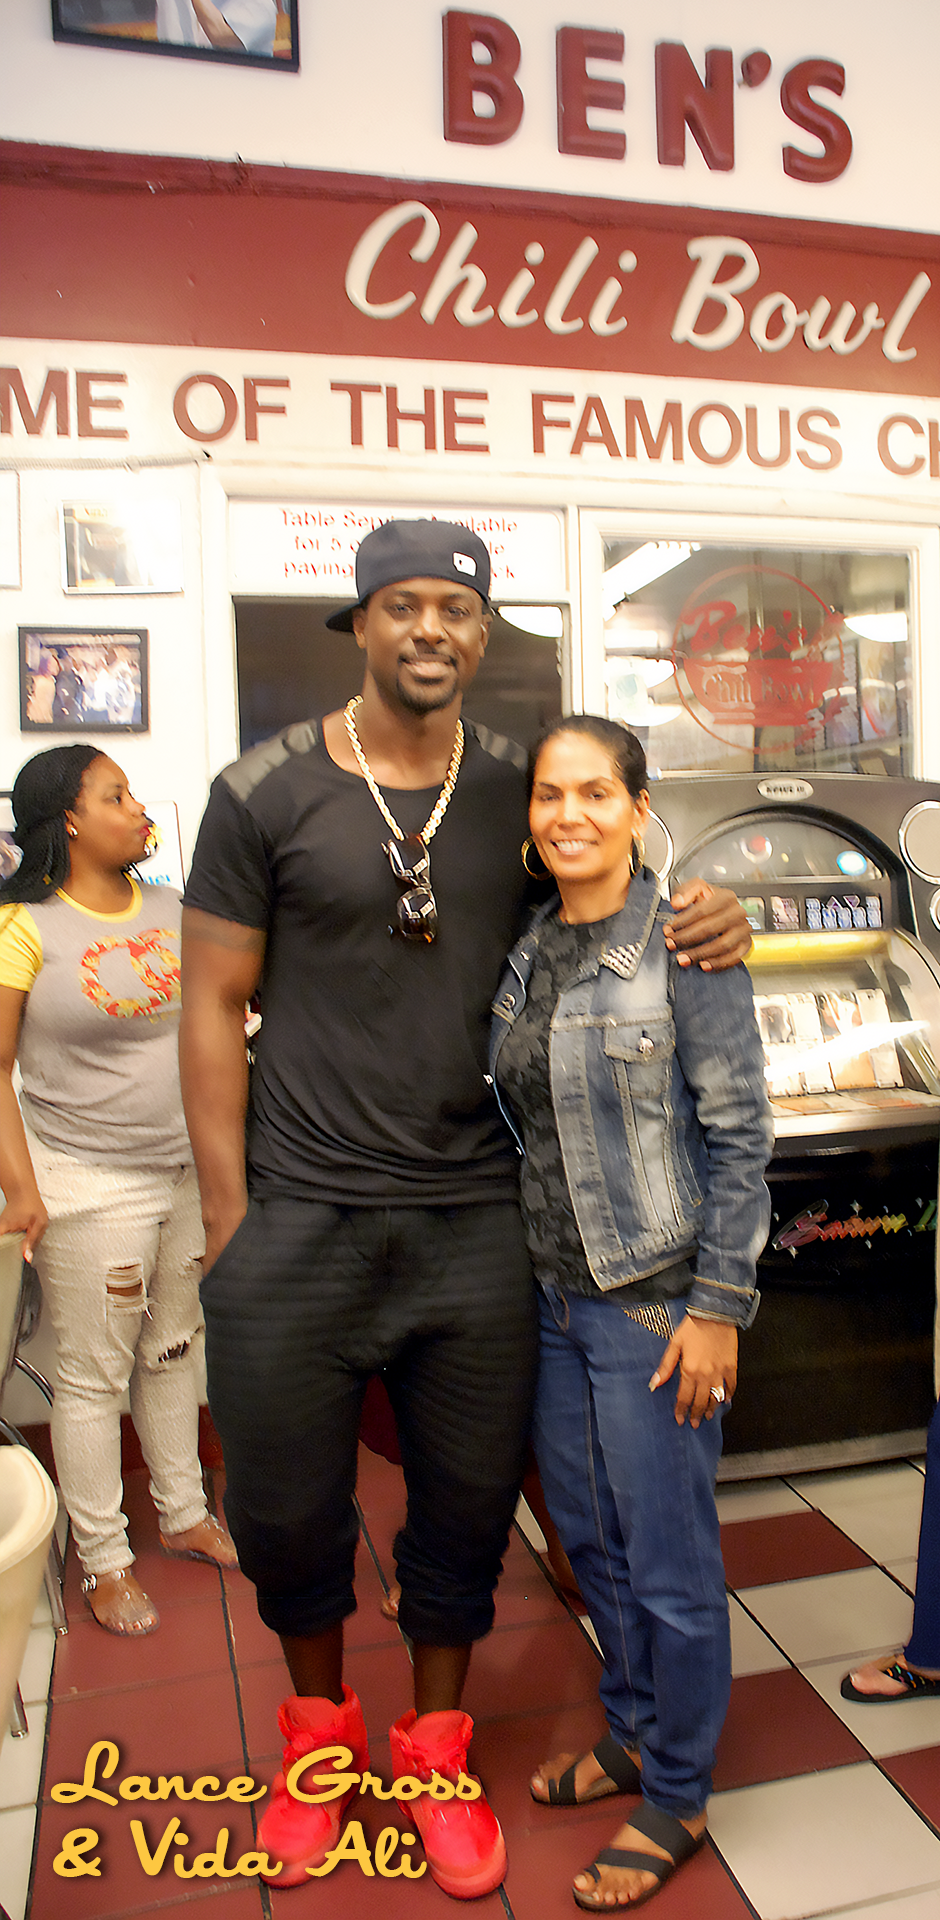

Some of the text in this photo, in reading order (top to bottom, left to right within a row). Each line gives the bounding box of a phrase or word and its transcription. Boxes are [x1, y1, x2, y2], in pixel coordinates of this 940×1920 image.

[441, 10, 853, 184] BEN'S
[345, 201, 932, 364] Chili Bowl
[0, 366, 129, 440] ME
[173, 373, 292, 444] OF
[330, 381, 491, 456] THE
[531, 393, 843, 471] FAMOUS
[281, 508, 336, 528] Table
[294, 535, 320, 551] for
[284, 561, 355, 579] paying
